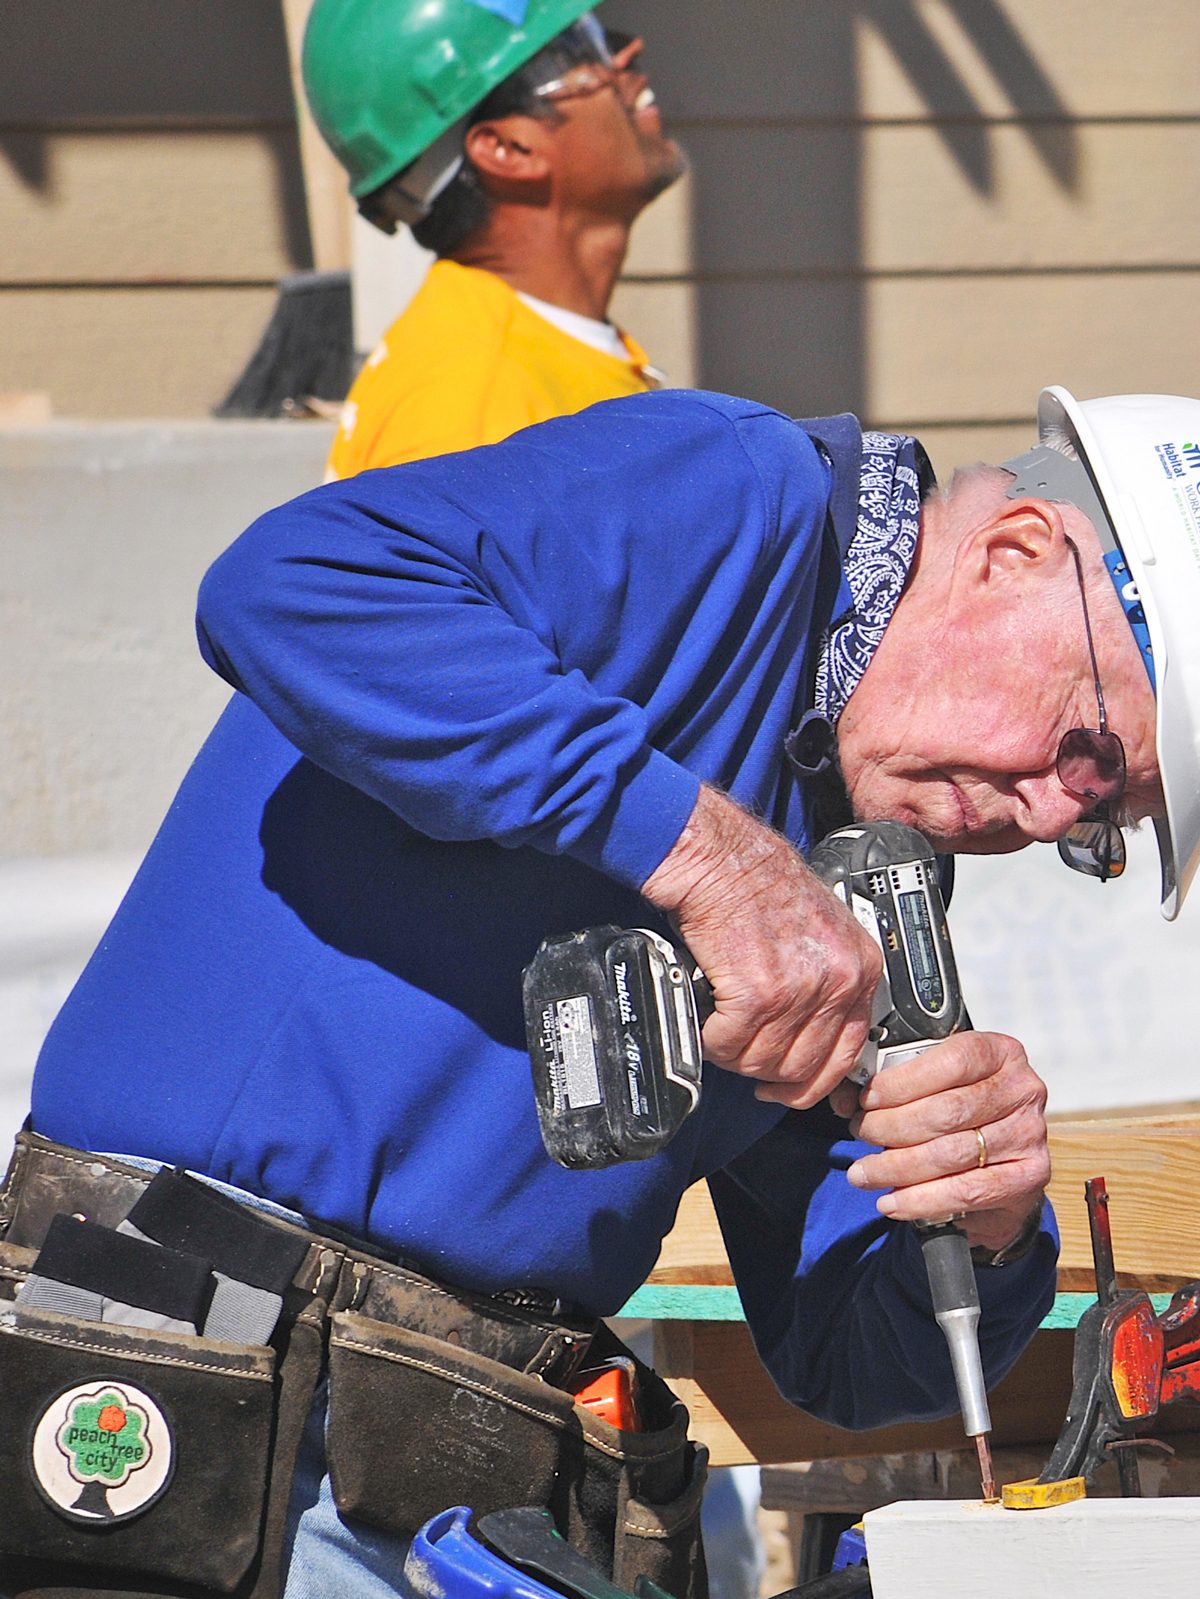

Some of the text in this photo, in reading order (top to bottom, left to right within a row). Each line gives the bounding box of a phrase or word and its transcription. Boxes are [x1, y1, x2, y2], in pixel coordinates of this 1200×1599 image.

[1162, 443, 1186, 478] Habitat
[1185, 483, 1200, 514] WORK
[613, 962, 632, 1025] makita
[68, 1427, 117, 1444] peach
[85, 1450, 117, 1473] city
[110, 1443, 144, 1460] tree
